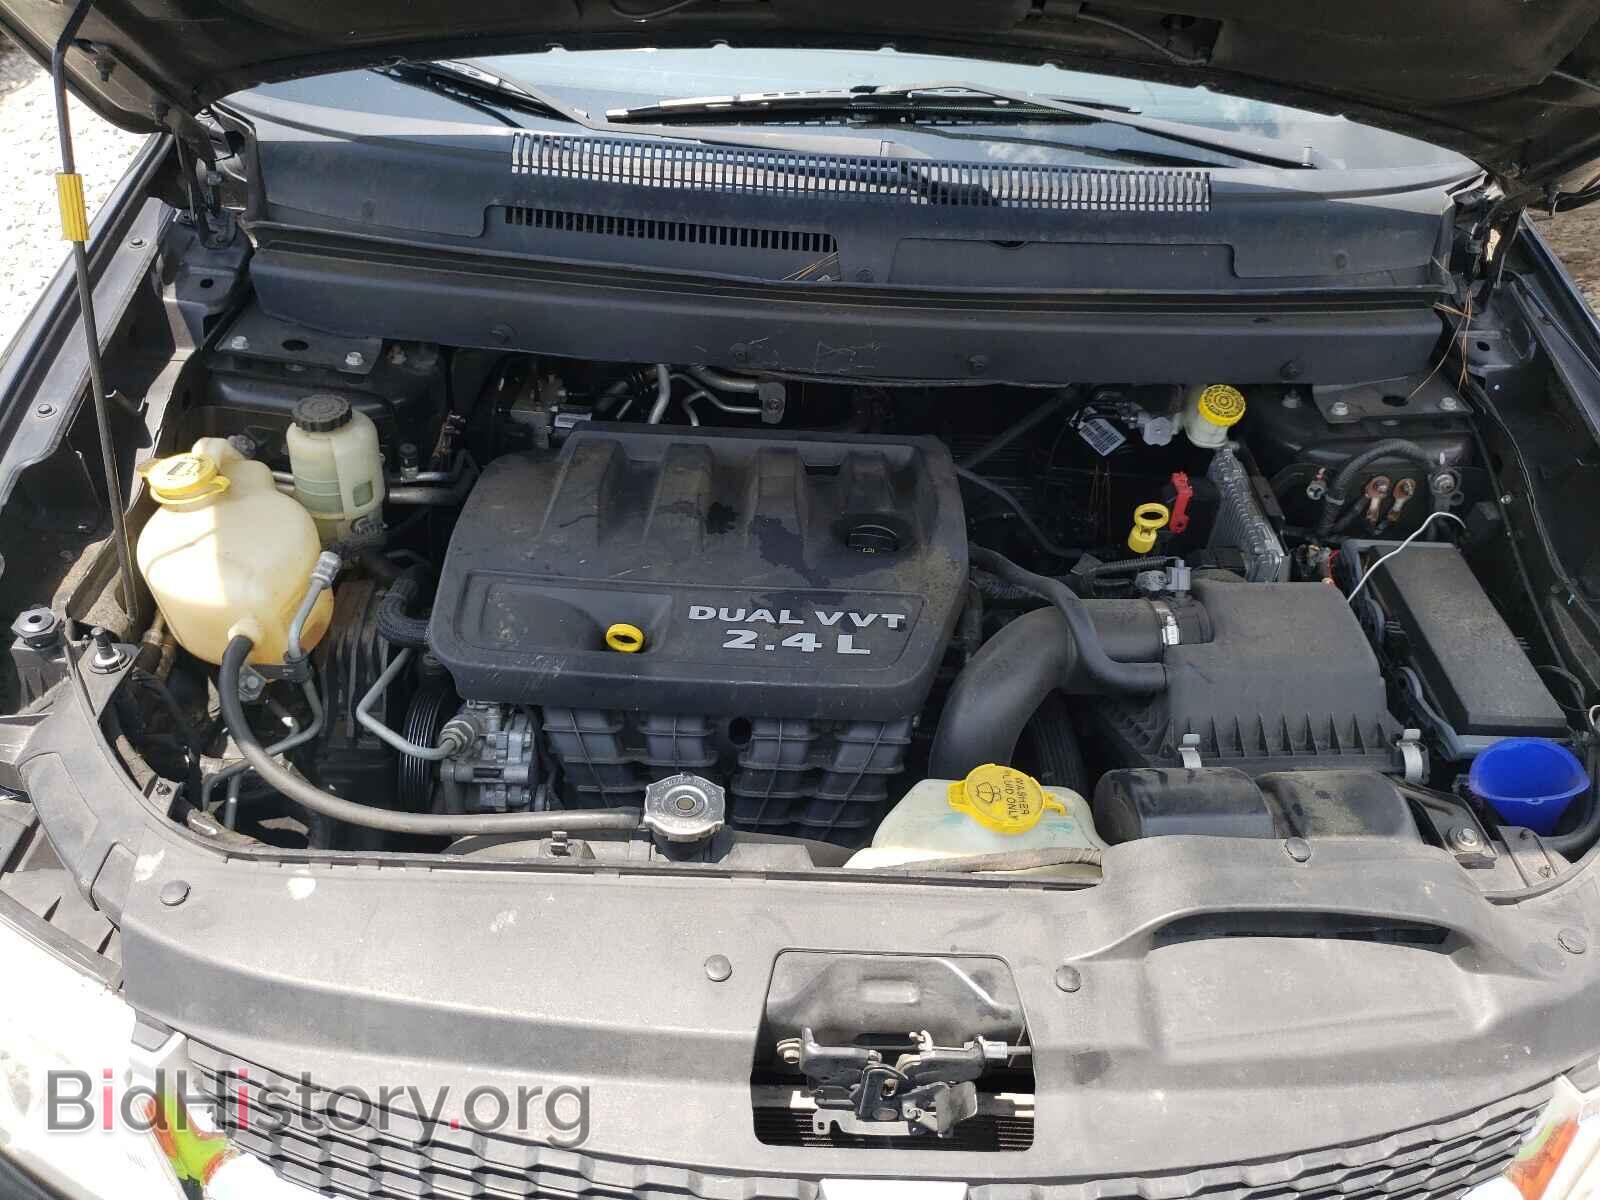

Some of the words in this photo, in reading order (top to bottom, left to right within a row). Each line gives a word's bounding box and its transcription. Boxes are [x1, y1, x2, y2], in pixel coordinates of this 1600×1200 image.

[687, 604, 805, 625] DUAL
[814, 610, 906, 629] VVT
[722, 629, 823, 653] 2.4
[837, 633, 871, 655] L
[1015, 777, 1030, 815] WASHER
